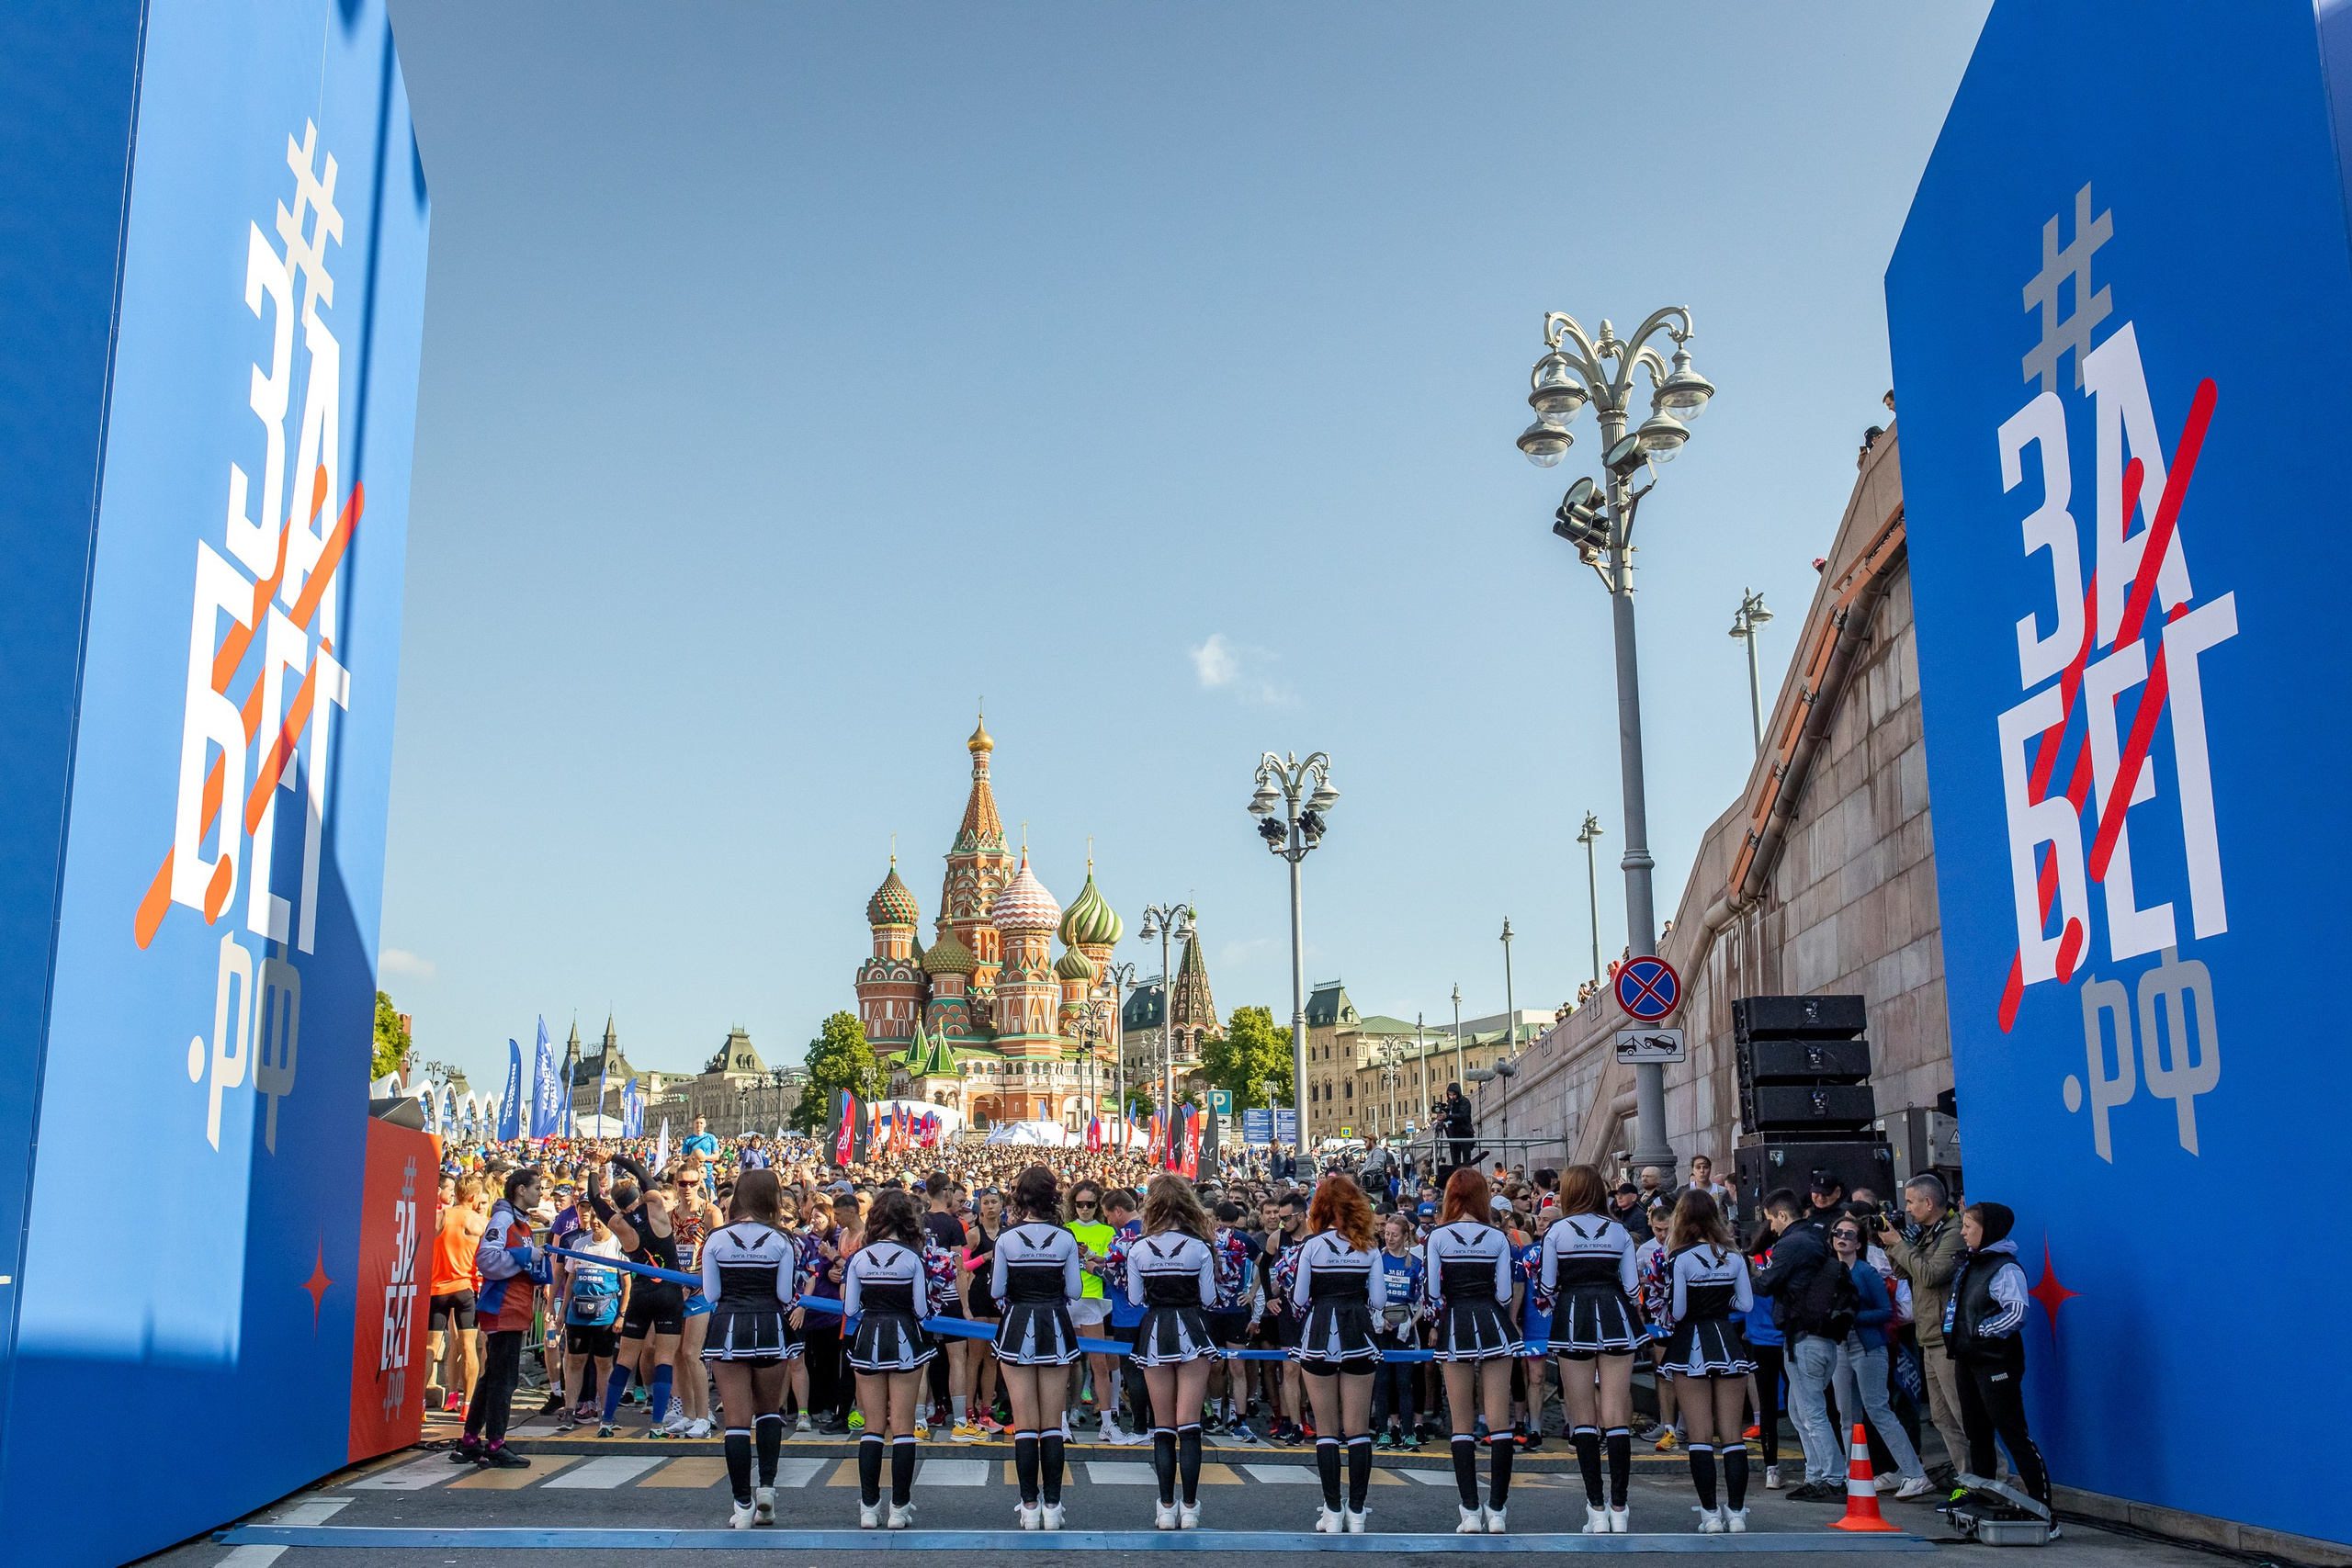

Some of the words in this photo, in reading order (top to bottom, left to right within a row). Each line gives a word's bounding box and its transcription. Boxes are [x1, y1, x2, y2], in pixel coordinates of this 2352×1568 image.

[226, 219, 340, 648] ЗА
[1997, 320, 2194, 691] ЗА
[171, 539, 351, 955] БЕГ
[1998, 591, 2239, 986] БЕГ
[540, 1053, 551, 1111] КАМЕРА
[1213, 1092, 1227, 1113] P
